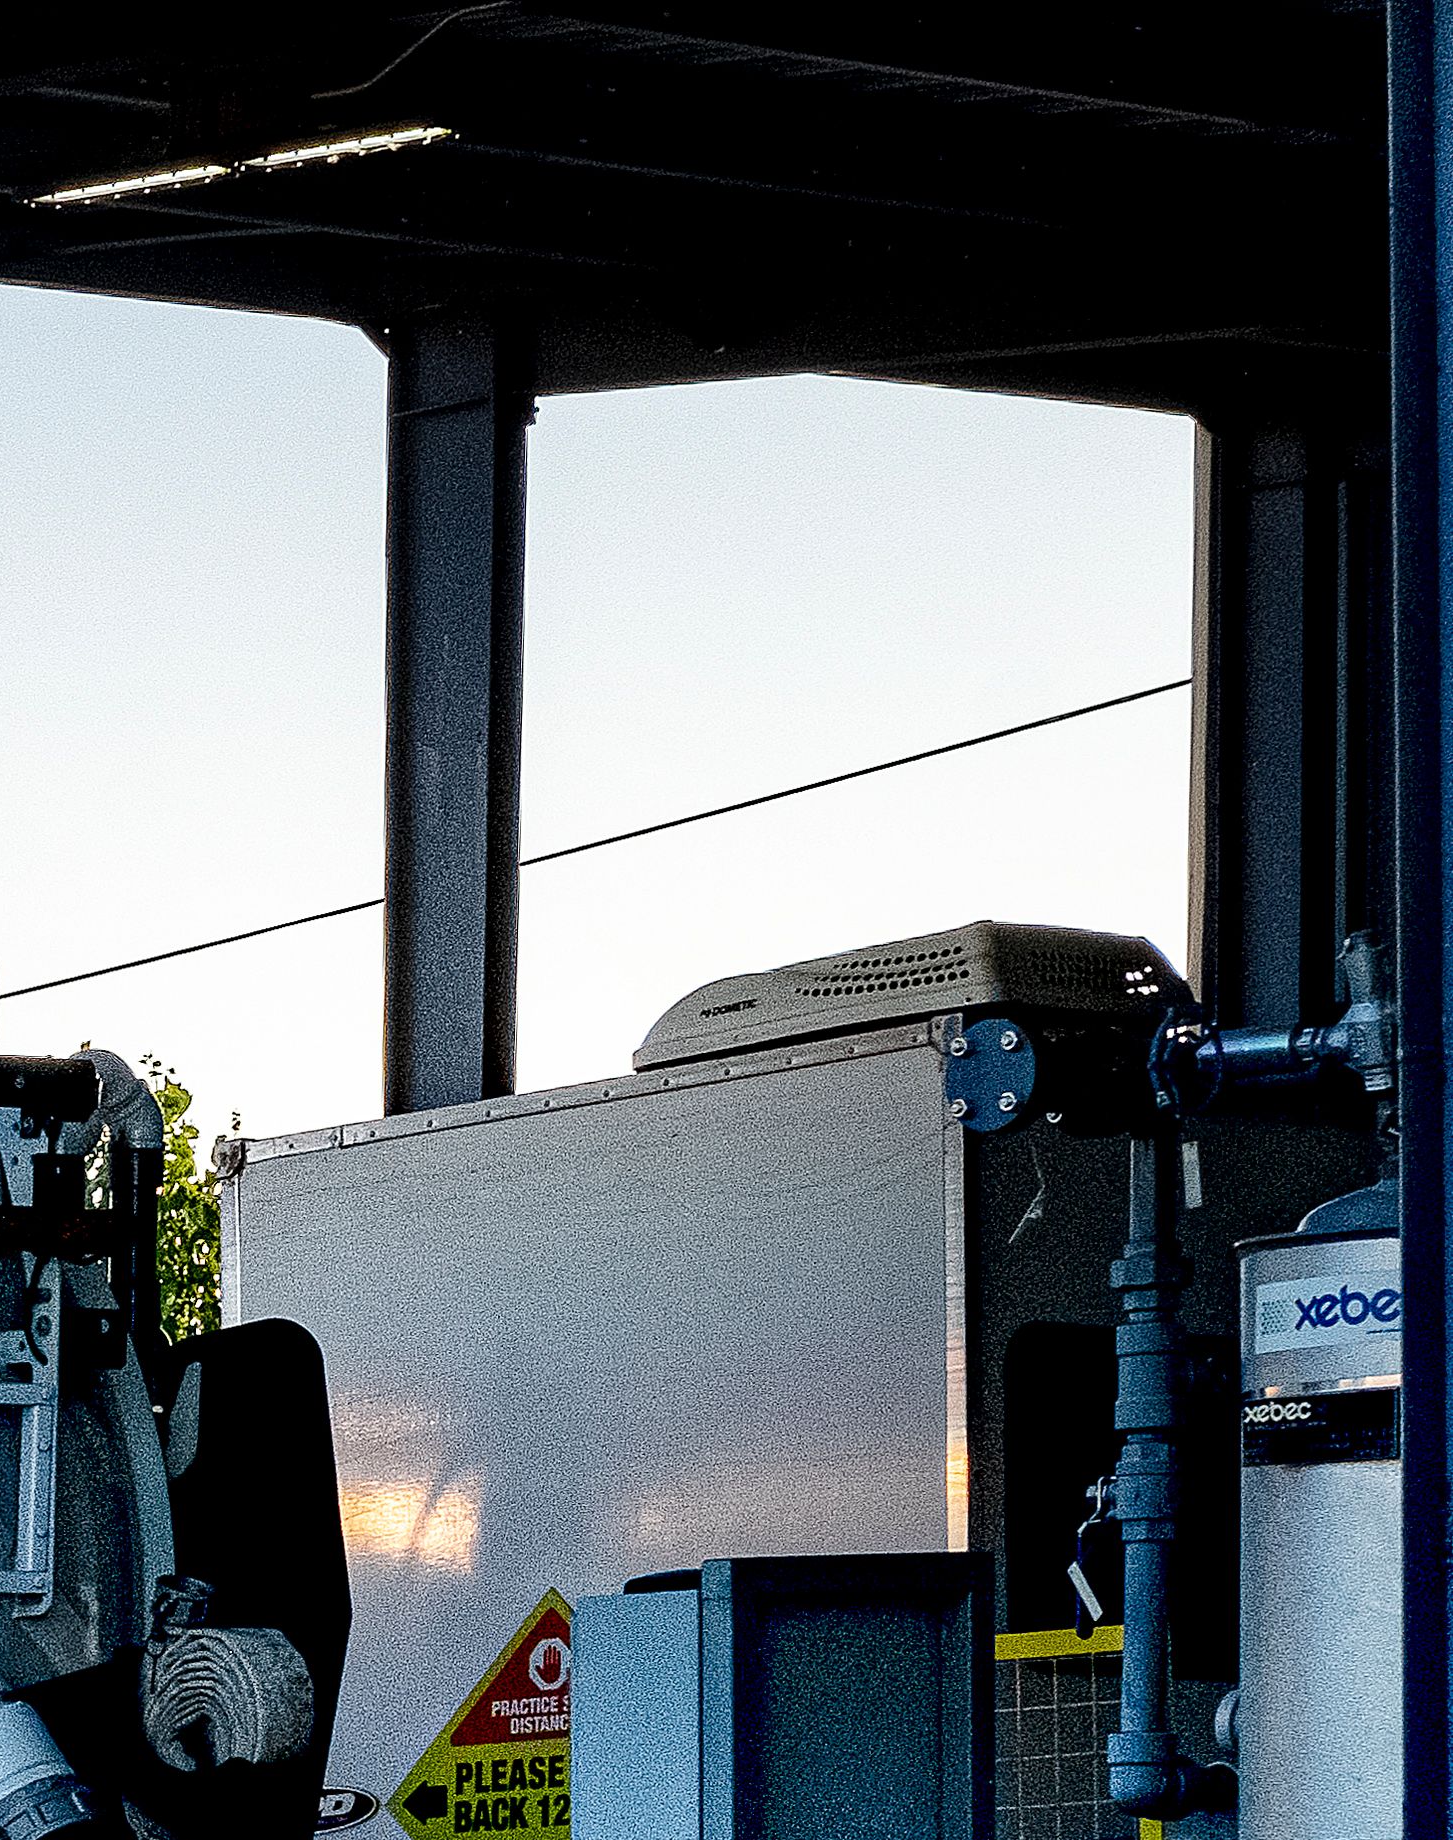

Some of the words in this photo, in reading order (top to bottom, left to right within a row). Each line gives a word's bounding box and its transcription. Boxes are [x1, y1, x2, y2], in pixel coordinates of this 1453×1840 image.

[1243, 1401, 1311, 1423] xebec
[491, 1697, 559, 1717] PRACTICE
[455, 1755, 565, 1796] PLEASE
[454, 1796, 529, 1834] BACK
[536, 1793, 570, 1828] 12
